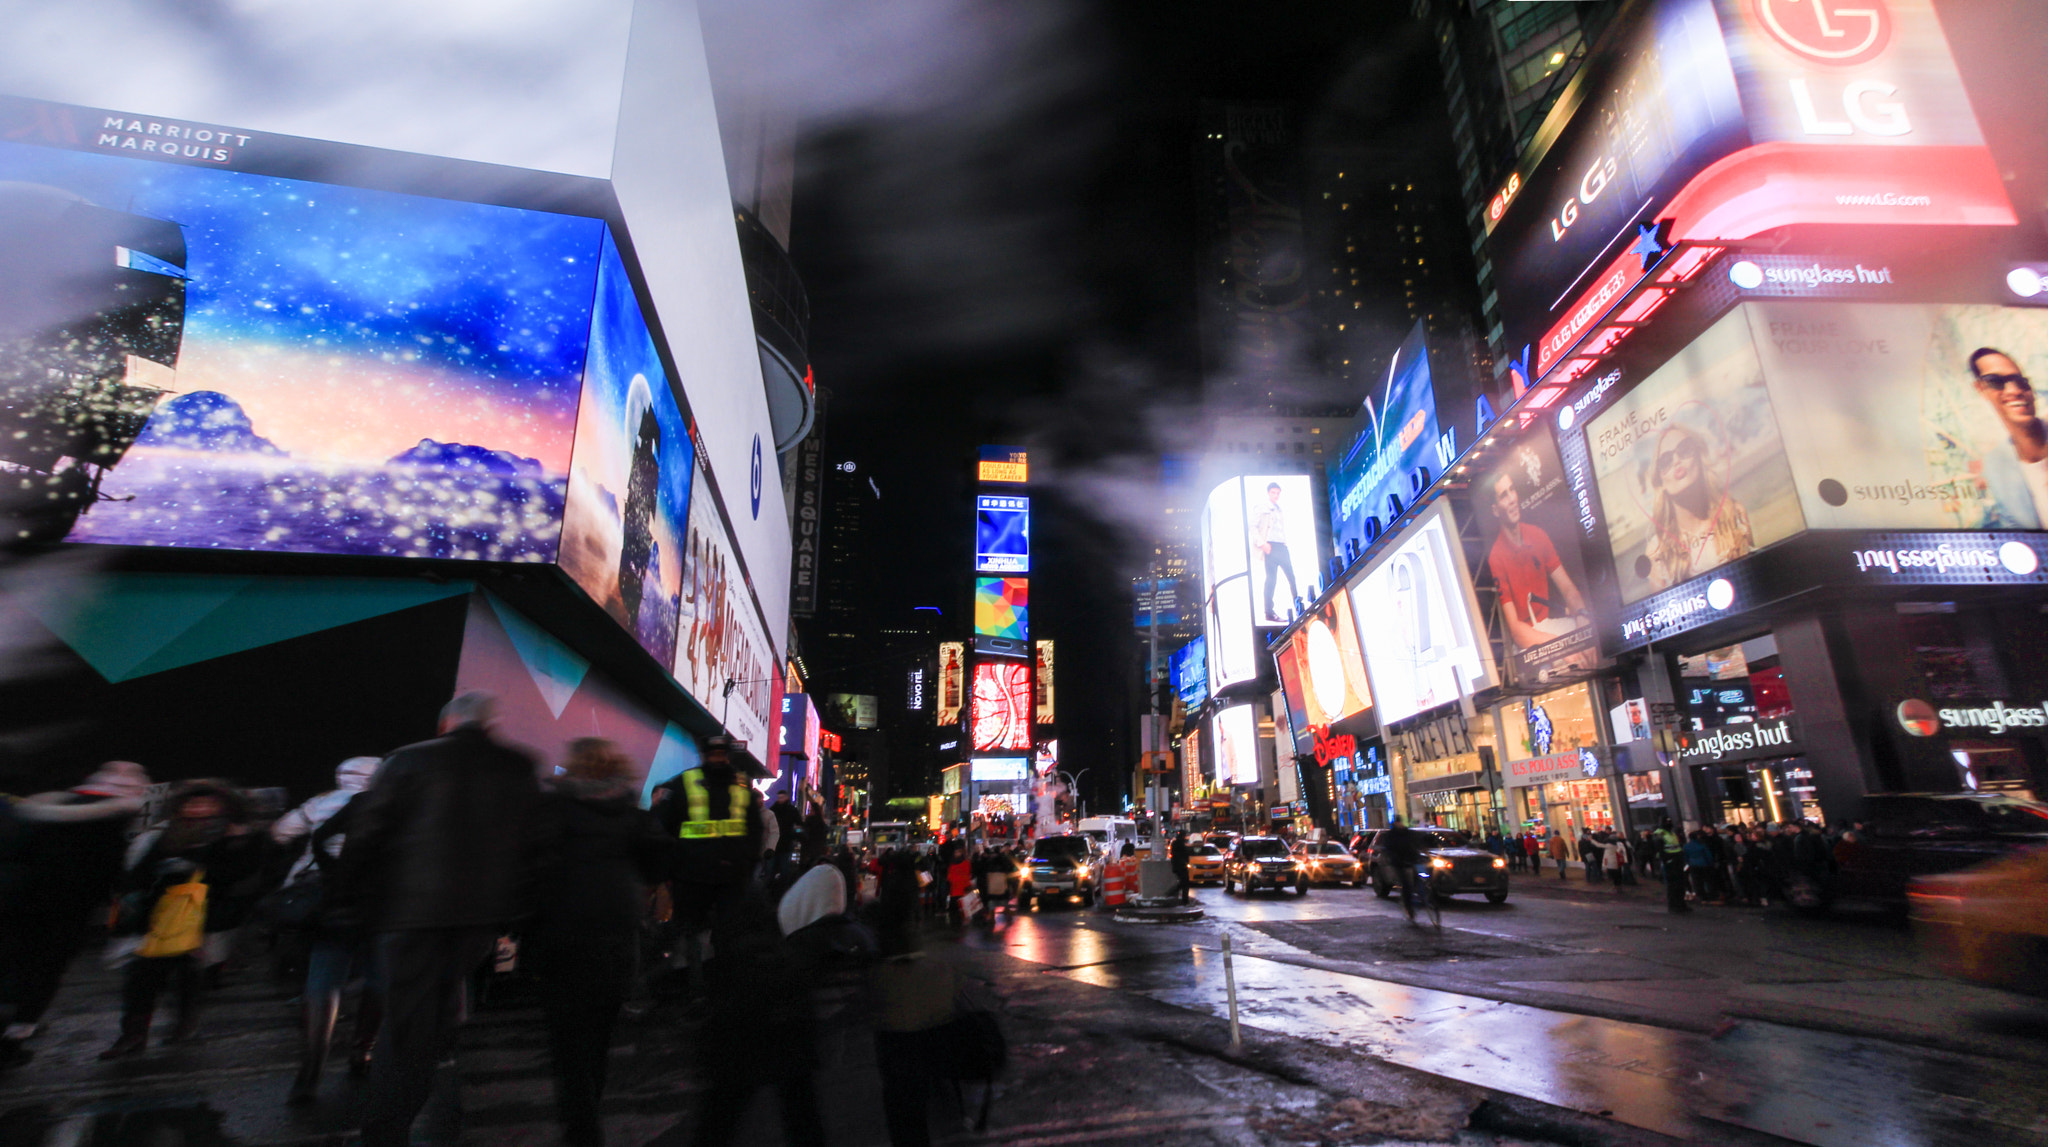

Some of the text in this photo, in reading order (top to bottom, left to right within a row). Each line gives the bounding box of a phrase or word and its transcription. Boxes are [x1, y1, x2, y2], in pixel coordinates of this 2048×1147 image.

[1789, 78, 1913, 136] LG
[98, 133, 228, 161] MARQUIS
[104, 117, 251, 147] MARRIOTT
[1501, 172, 1520, 205] LG
[1551, 197, 1579, 242] LG
[1765, 263, 1894, 288] sunglass hut
[1573, 367, 1622, 415] sunglass
[1599, 410, 1639, 447] FRAME
[1601, 407, 1668, 462] YOUR LOVE
[1853, 479, 1951, 506] sunglass
[797, 490, 818, 586] SQUARE
[987, 557, 1018, 565] XINHUA
[1852, 543, 2000, 575] sunglass hut
[1621, 593, 1708, 641] sunglass hut
[1523, 650, 1538, 664] LIVE
[1752, 720, 1793, 747] hut
[1939, 701, 2046, 735] sunglass
[1511, 764, 1528, 776] U.S.
[1529, 759, 1555, 775] POLO
[1529, 775, 1549, 783] SINCE
